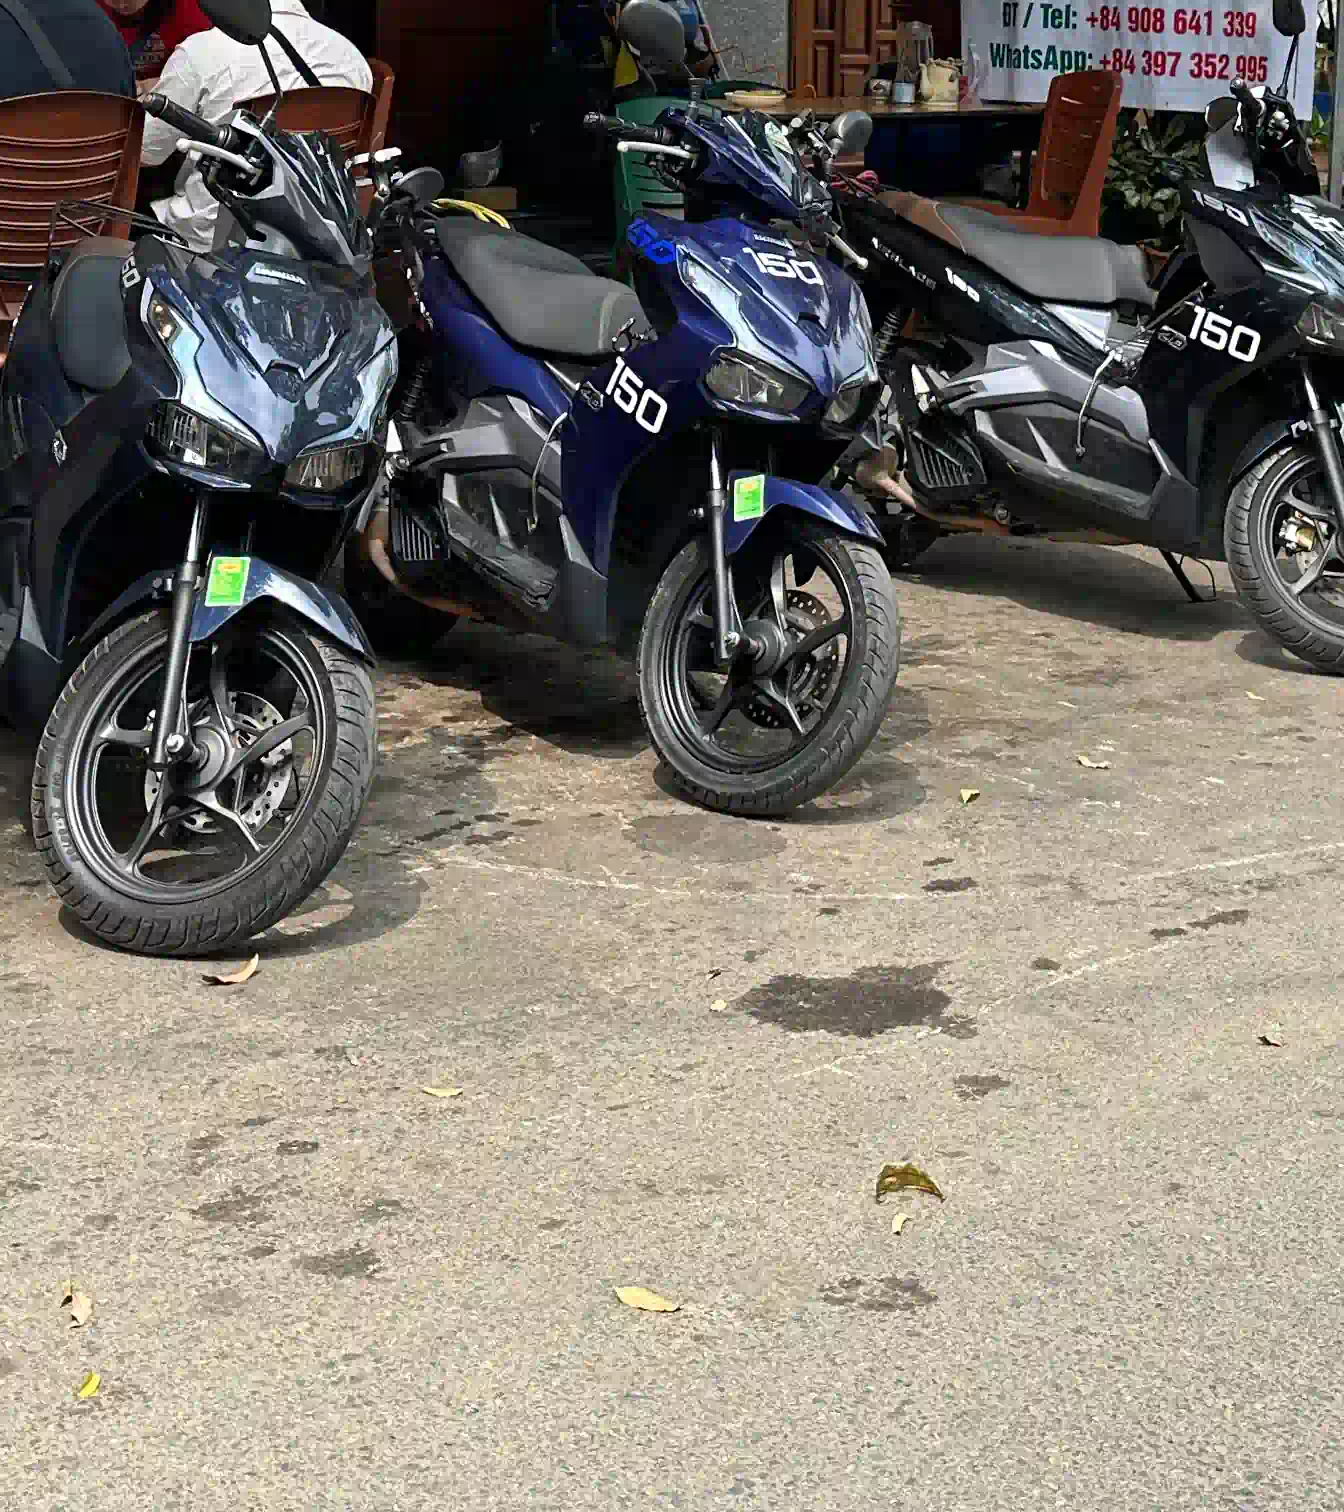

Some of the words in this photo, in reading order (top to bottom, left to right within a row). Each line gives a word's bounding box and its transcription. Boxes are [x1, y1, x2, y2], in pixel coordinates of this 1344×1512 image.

[1022, 1, 1034, 19] /
[1040, 3, 1077, 31] Tel:
[1085, 6, 1121, 32] +84
[1128, 8, 1165, 34] 908
[1173, 9, 1214, 37] 641
[1223, 10, 1257, 38] 339
[989, 42, 1094, 75] WhatsApp:
[1099, 50, 1136, 75] +84
[1142, 51, 1179, 78] 397
[1189, 52, 1230, 80] 352
[1236, 54, 1269, 82] 995
[1191, 188, 1250, 227] 150
[742, 246, 824, 286] 150
[1189, 305, 1261, 363] 150
[605, 355, 668, 434] 150
